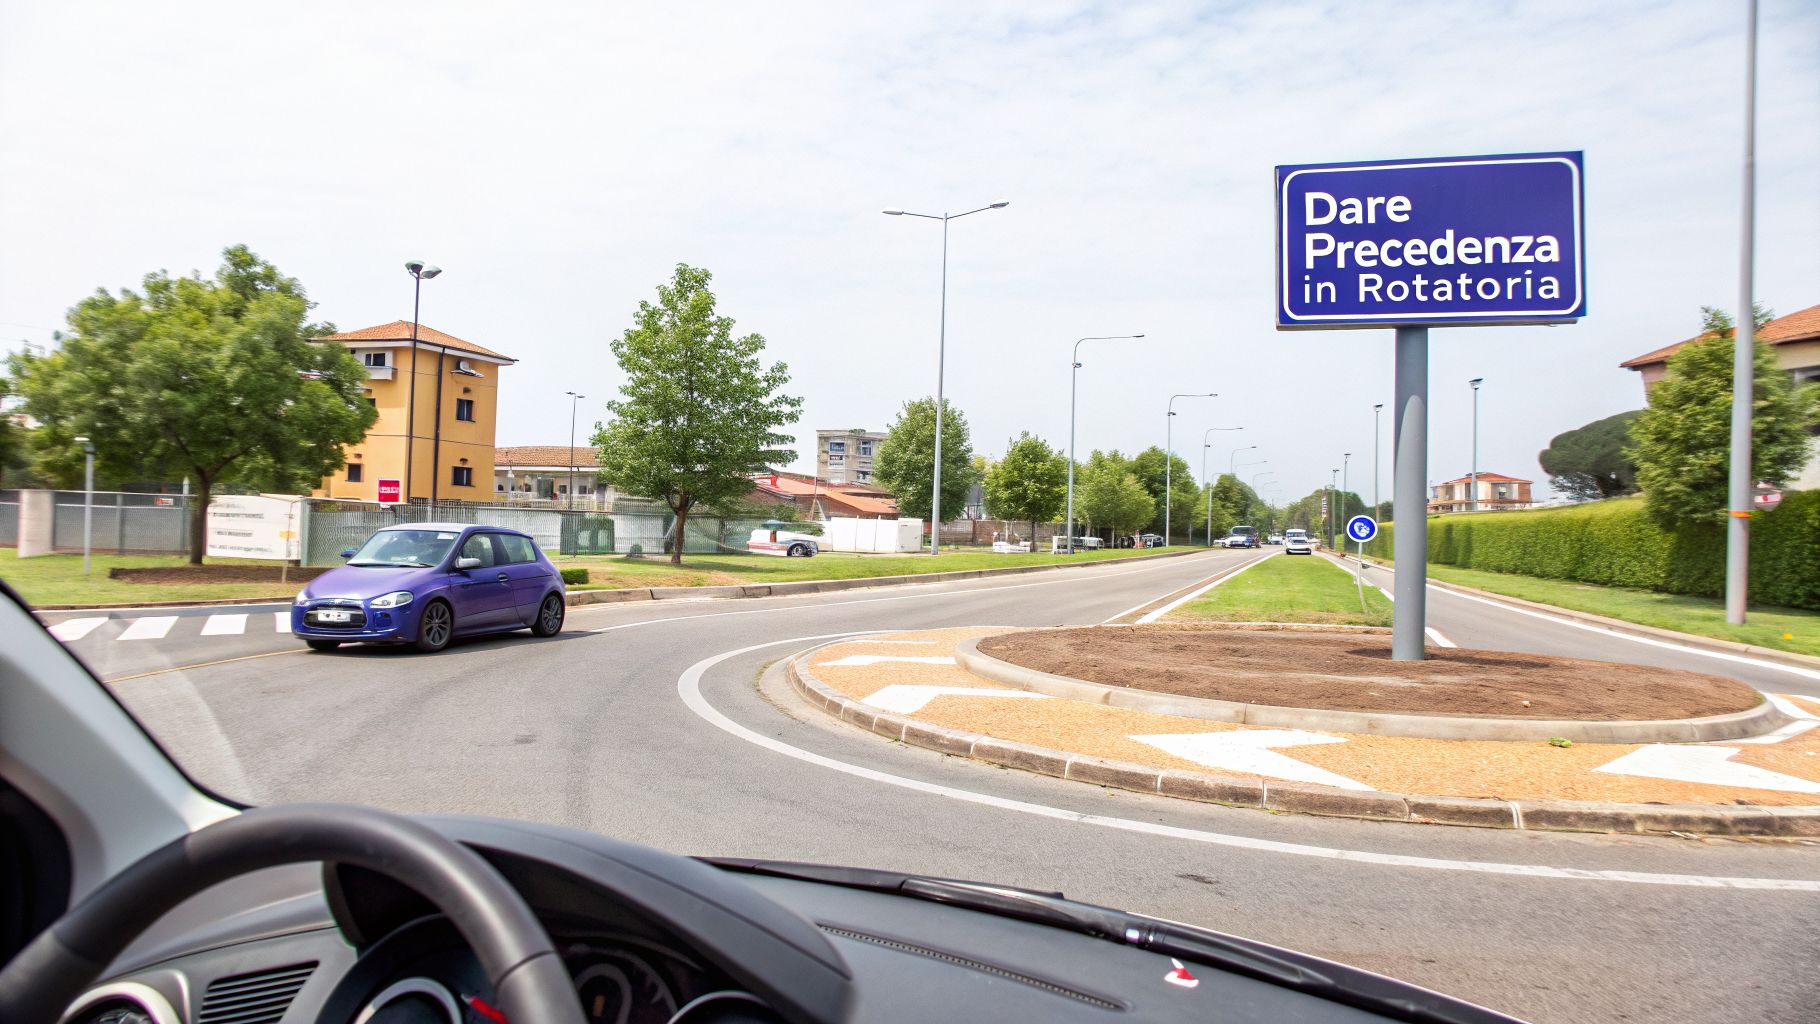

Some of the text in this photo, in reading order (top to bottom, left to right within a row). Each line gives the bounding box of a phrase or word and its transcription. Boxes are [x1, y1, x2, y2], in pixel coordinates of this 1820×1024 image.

[1304, 191, 1412, 226] Dare
[1304, 229, 1561, 270] Precedenza
[1304, 274, 1337, 303] in
